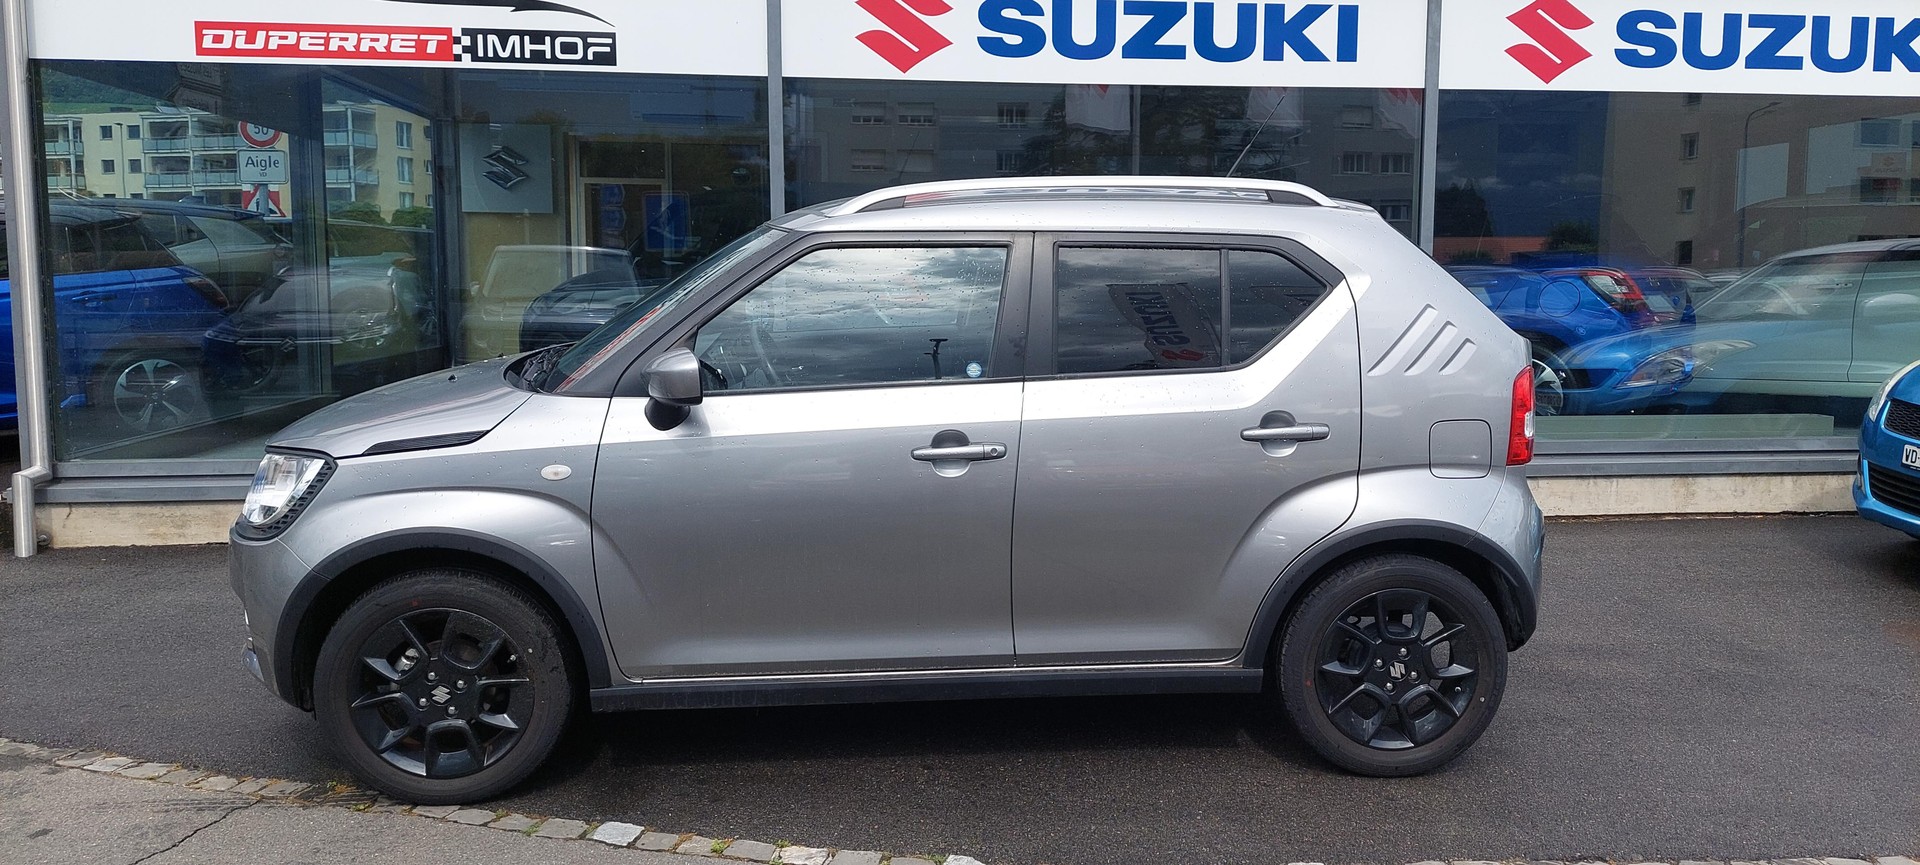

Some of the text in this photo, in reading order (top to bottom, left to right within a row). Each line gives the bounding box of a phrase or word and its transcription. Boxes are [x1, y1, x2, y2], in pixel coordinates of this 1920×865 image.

[201, 28, 613, 61] DUPERRET IMHOF
[977, 0, 1359, 63] SUZUKI
[245, 155, 280, 171] Aigle
